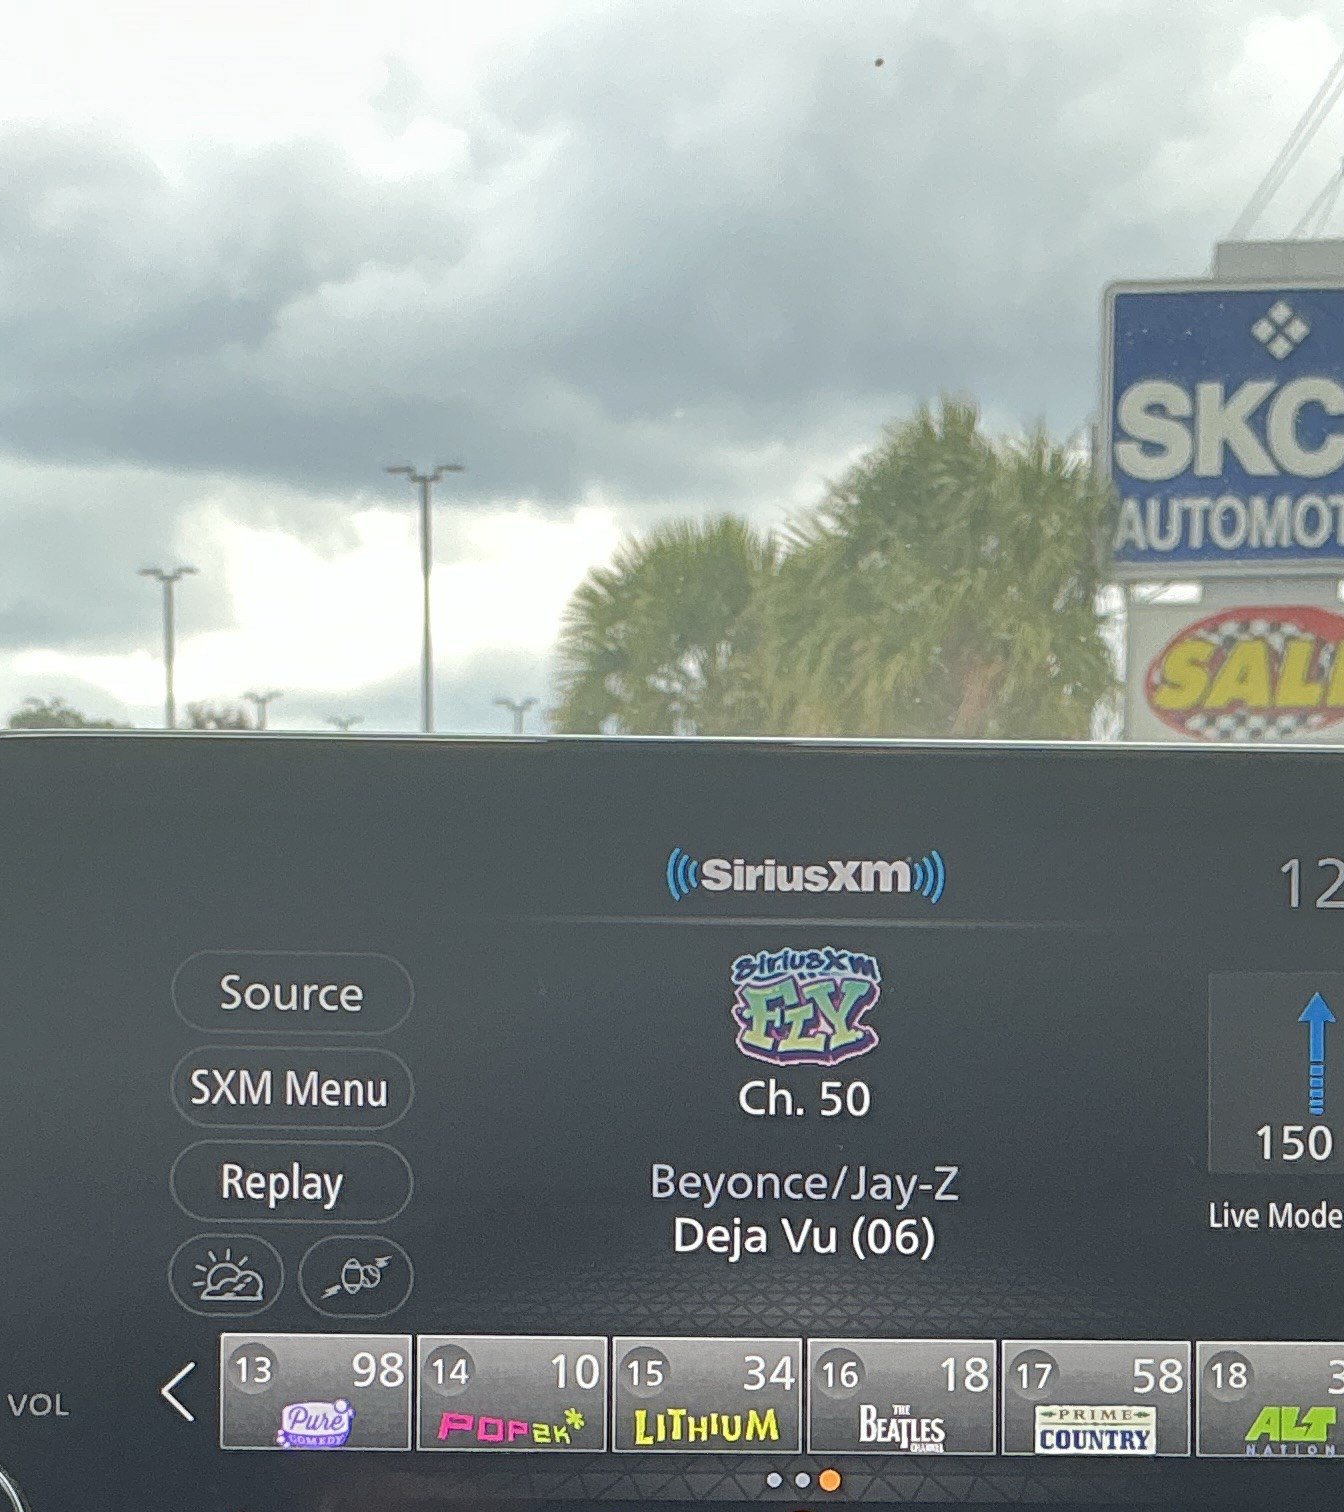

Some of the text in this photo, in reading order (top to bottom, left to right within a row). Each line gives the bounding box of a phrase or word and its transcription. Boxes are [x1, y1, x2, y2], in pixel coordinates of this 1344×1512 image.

[220, 973, 365, 1013] Source
[740, 973, 874, 1053] FLY
[190, 1068, 389, 1108] SXM Menu
[738, 1077, 872, 1118] Ch. 50
[1256, 1123, 1334, 1162] 150
[221, 1161, 345, 1211] Replay
[1208, 1201, 1344, 1230] Live Mode
[674, 1215, 936, 1264] Deja Vu (06)
[235, 1355, 272, 1384] 13
[352, 1351, 406, 1388] 98
[431, 1357, 470, 1386] 14
[551, 1353, 601, 1390] 10
[627, 1359, 665, 1388] 15
[743, 1355, 796, 1392] 34
[821, 1361, 859, 1389] 16
[940, 1357, 991, 1394] 18
[1015, 1362, 1053, 1390] 17
[1131, 1359, 1185, 1395] 58
[1211, 1362, 1249, 1389] 18
[7, 1393, 70, 1417] VOL
[287, 1404, 346, 1431] Pure
[891, 1404, 912, 1416] THE
[1058, 1409, 1134, 1422] PRIME
[633, 1408, 780, 1446] LITHIUM
[858, 1404, 947, 1449] BEATLES
[1039, 1429, 1152, 1453] COUNTRY
[1244, 1405, 1338, 1442] ALT
[1245, 1443, 1337, 1458] NATION
